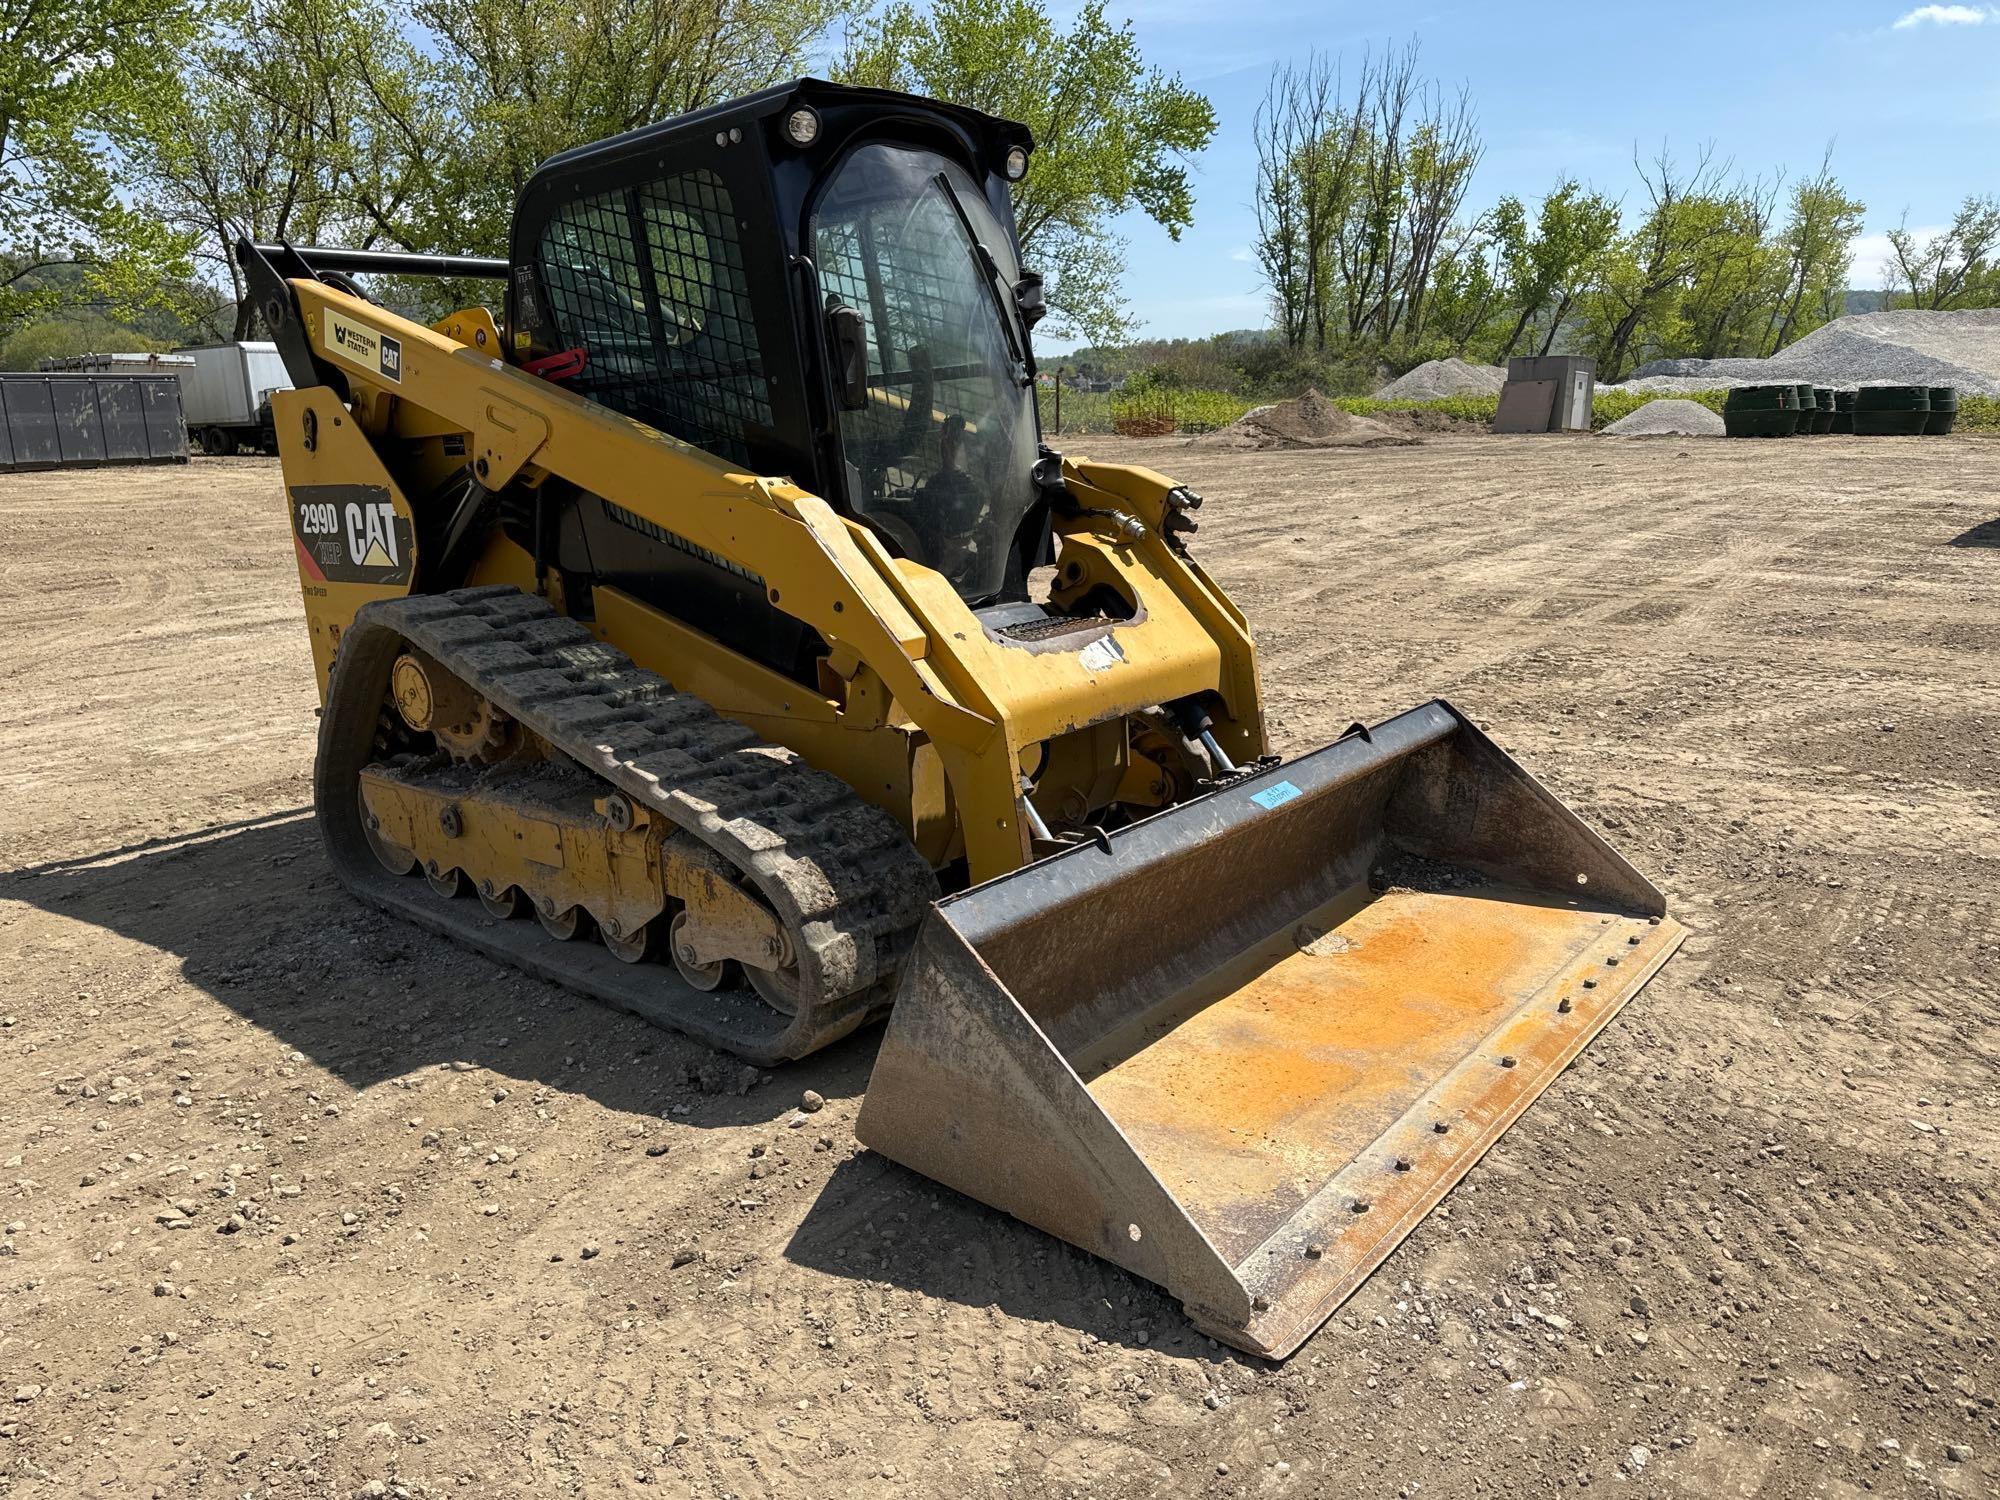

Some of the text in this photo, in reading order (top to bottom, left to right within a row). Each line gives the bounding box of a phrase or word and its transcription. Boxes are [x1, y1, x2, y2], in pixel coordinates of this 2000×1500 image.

[347, 329, 376, 350] WESTERN
[347, 340, 368, 356] STATES
[382, 345, 398, 370] CAT
[300, 503, 339, 534] 299D
[345, 502, 399, 567] CAT
[318, 541, 342, 565] XHP
